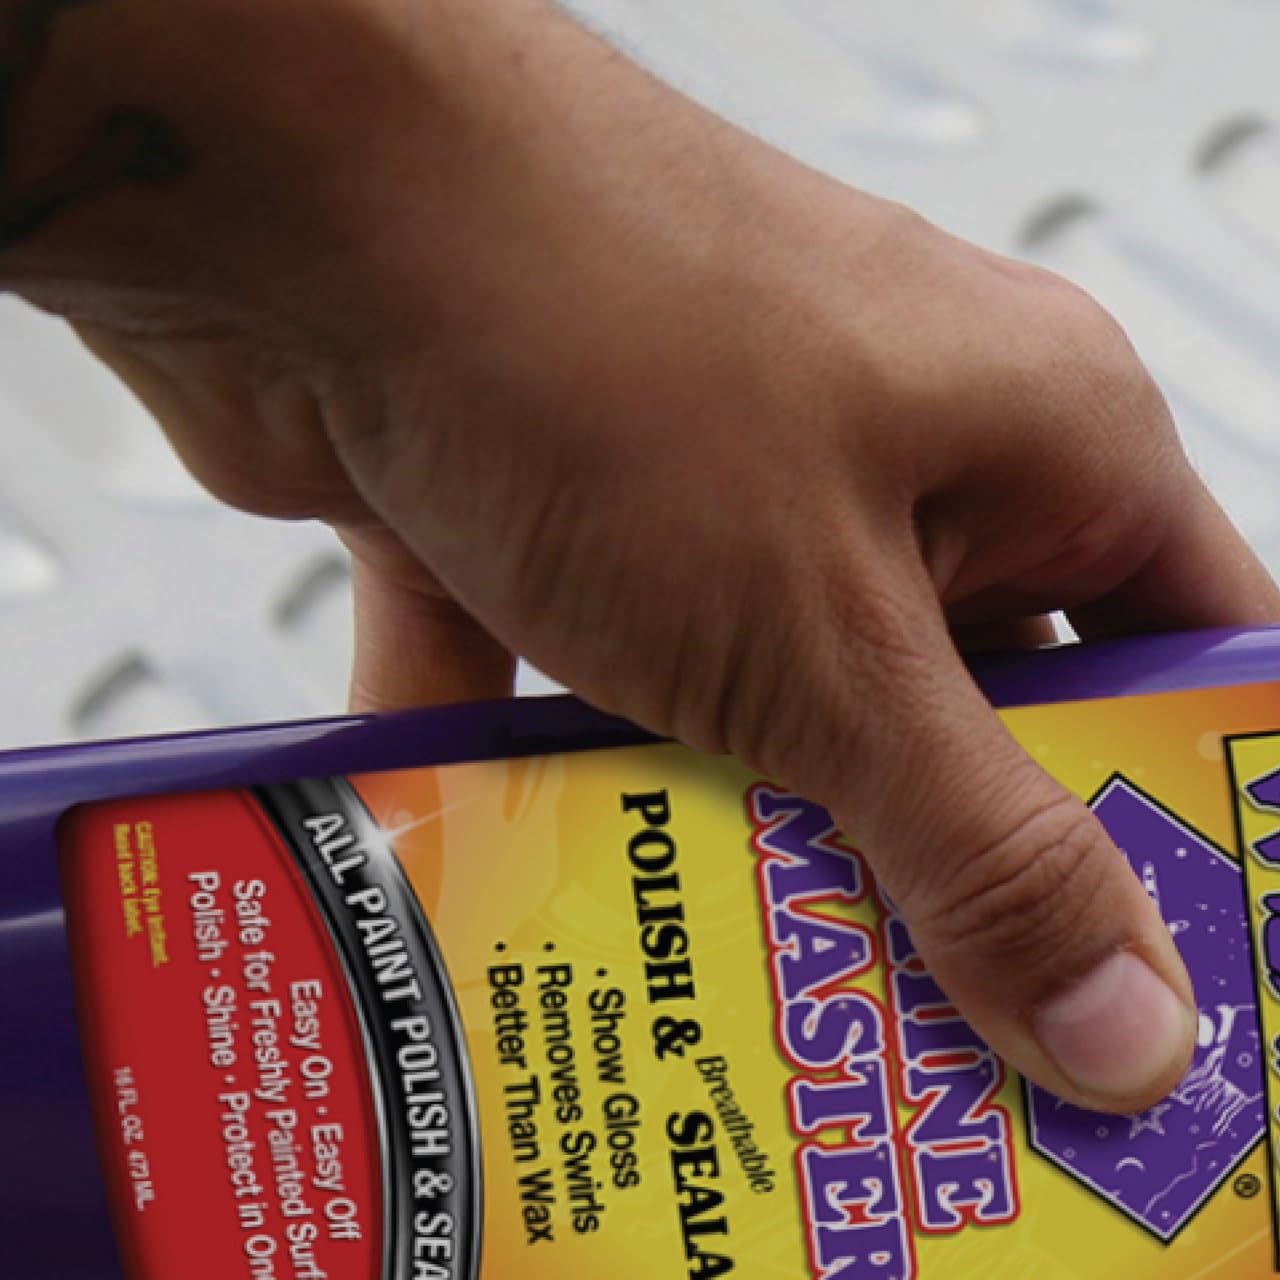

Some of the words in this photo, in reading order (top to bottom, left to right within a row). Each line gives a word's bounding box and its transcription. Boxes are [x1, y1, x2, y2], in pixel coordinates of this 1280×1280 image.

[302, 813, 367, 884] ALL
[188, 870, 229, 961] Polish
[233, 879, 272, 945] Safe
[621, 789, 695, 1003] POLISH
[243, 951, 275, 993] for
[345, 887, 422, 1001] PAINT
[203, 985, 240, 1067] Shine
[249, 999, 293, 1103] Freshly
[289, 979, 323, 1050] Easy
[487, 962, 529, 1069] Better
[588, 987, 626, 1083] Show
[652, 1016, 702, 1061] &
[300, 1055, 333, 1099] On
[390, 1015, 451, 1157] POLISH
[535, 962, 583, 1124] Removes
[560, 1130, 605, 1234] Swirls
[880, 892, 1019, 1232] INE
[217, 1091, 264, 1199] Protect
[264, 1108, 314, 1218] Painted
[310, 1122, 345, 1192] Easy
[503, 1075, 541, 1163] Than
[602, 1093, 640, 1189] Gloss
[695, 1055, 775, 1193] Breathable
[237, 1202, 269, 1229] in
[324, 1197, 361, 1240] Off
[412, 1167, 454, 1199] &
[517, 1168, 556, 1244] Wax
